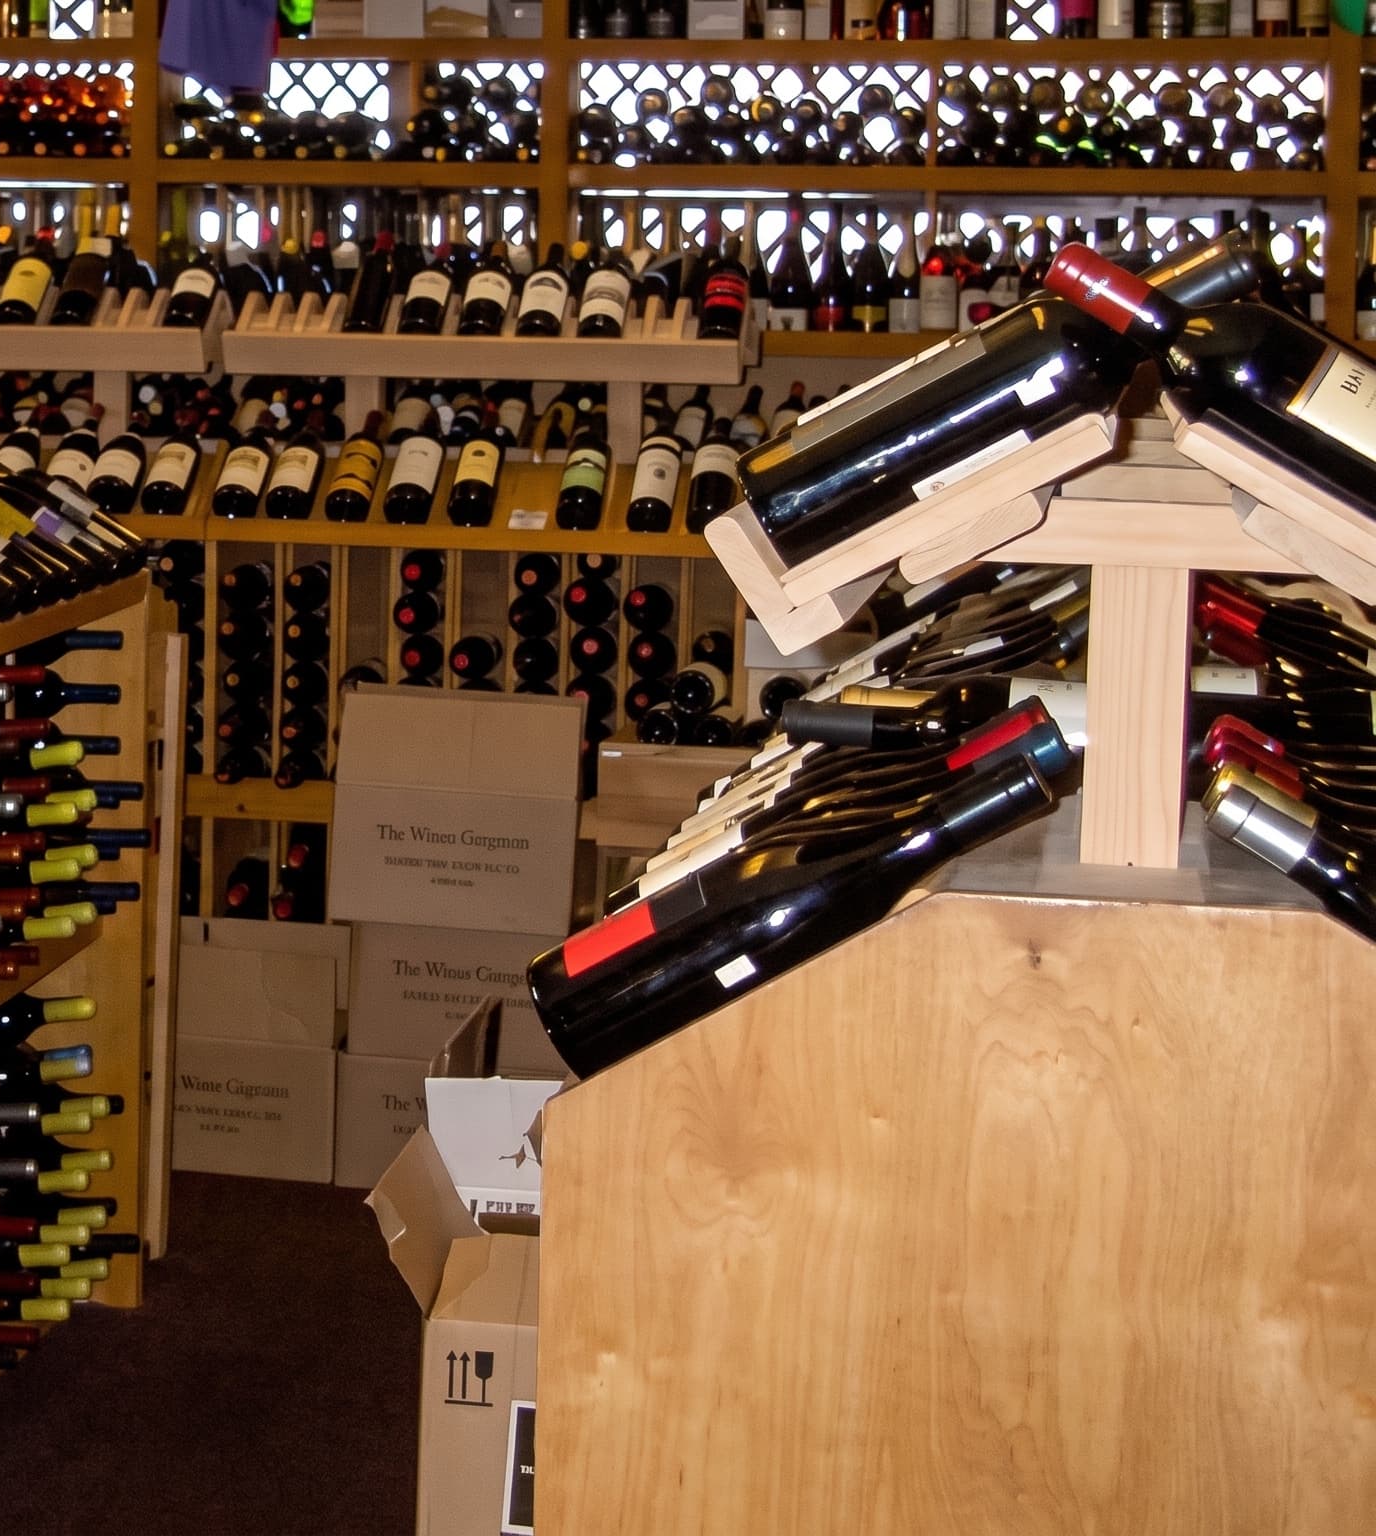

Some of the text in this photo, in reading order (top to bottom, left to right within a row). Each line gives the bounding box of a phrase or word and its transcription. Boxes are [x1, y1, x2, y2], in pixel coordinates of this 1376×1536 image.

[376, 824, 405, 841] The
[392, 959, 421, 977] The
[382, 1094, 411, 1111] The
